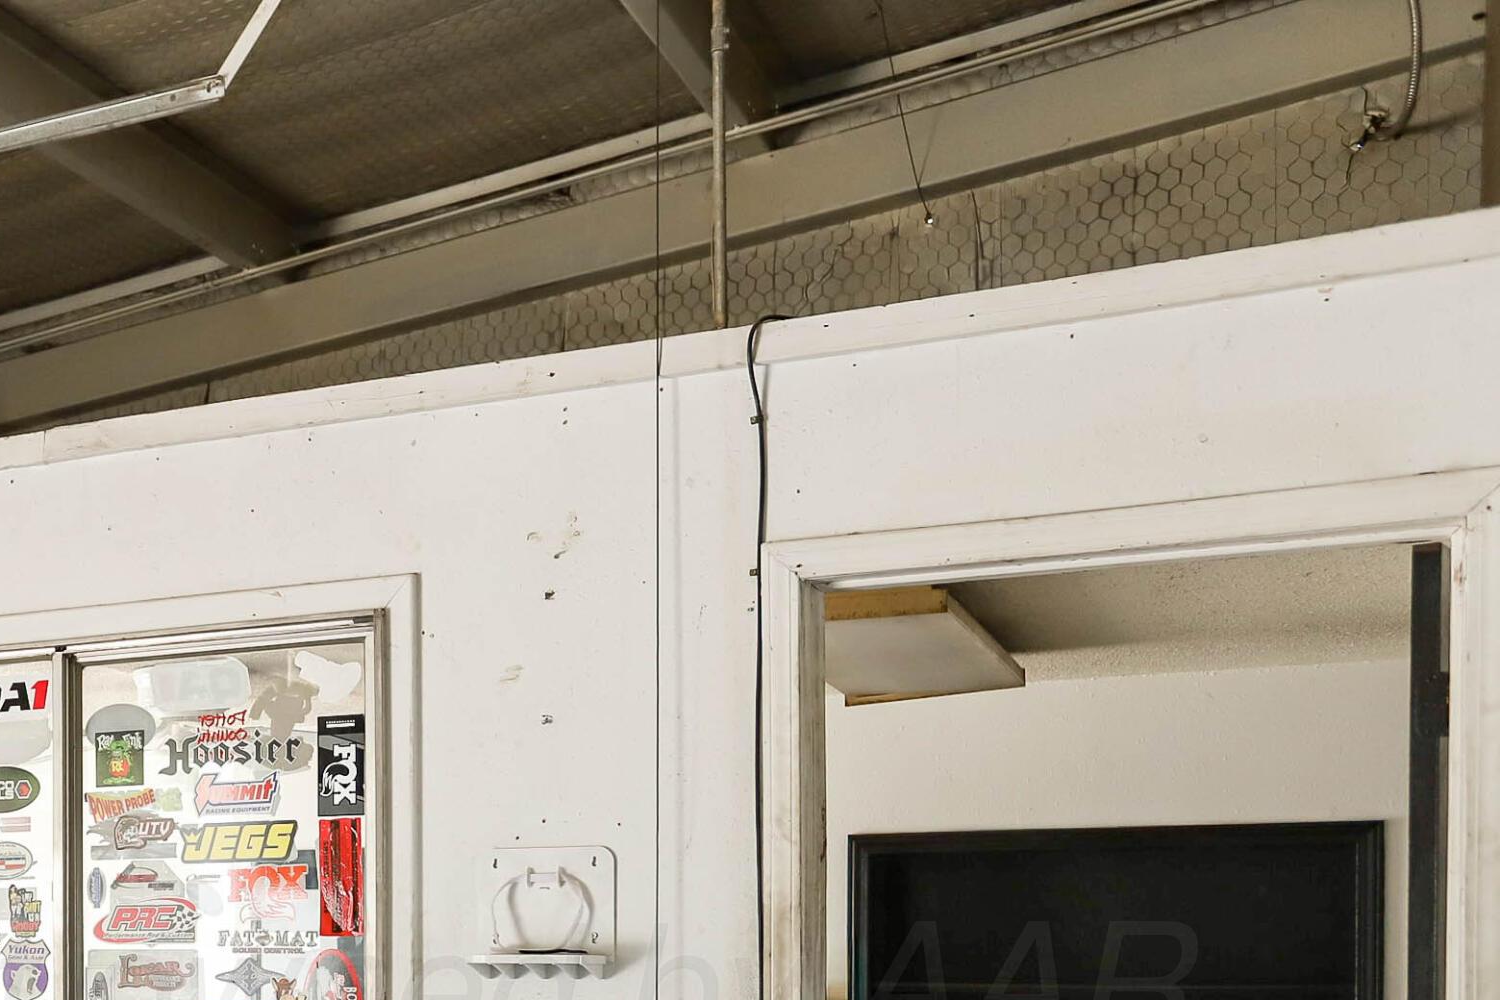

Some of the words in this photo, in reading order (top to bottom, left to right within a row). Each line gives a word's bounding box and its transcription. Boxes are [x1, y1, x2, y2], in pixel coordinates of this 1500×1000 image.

[159, 729, 301, 776] Hoosier
[330, 743, 357, 806] FOX
[87, 793, 125, 823] POWER
[125, 788, 156, 811] PROBE
[231, 806, 271, 814] EQUIPMENT
[183, 823, 295, 860] JEGS
[228, 865, 308, 902] FOX
[9, 945, 45, 954] Yukon
[218, 930, 256, 947] FAT
[274, 930, 318, 947] MAT
